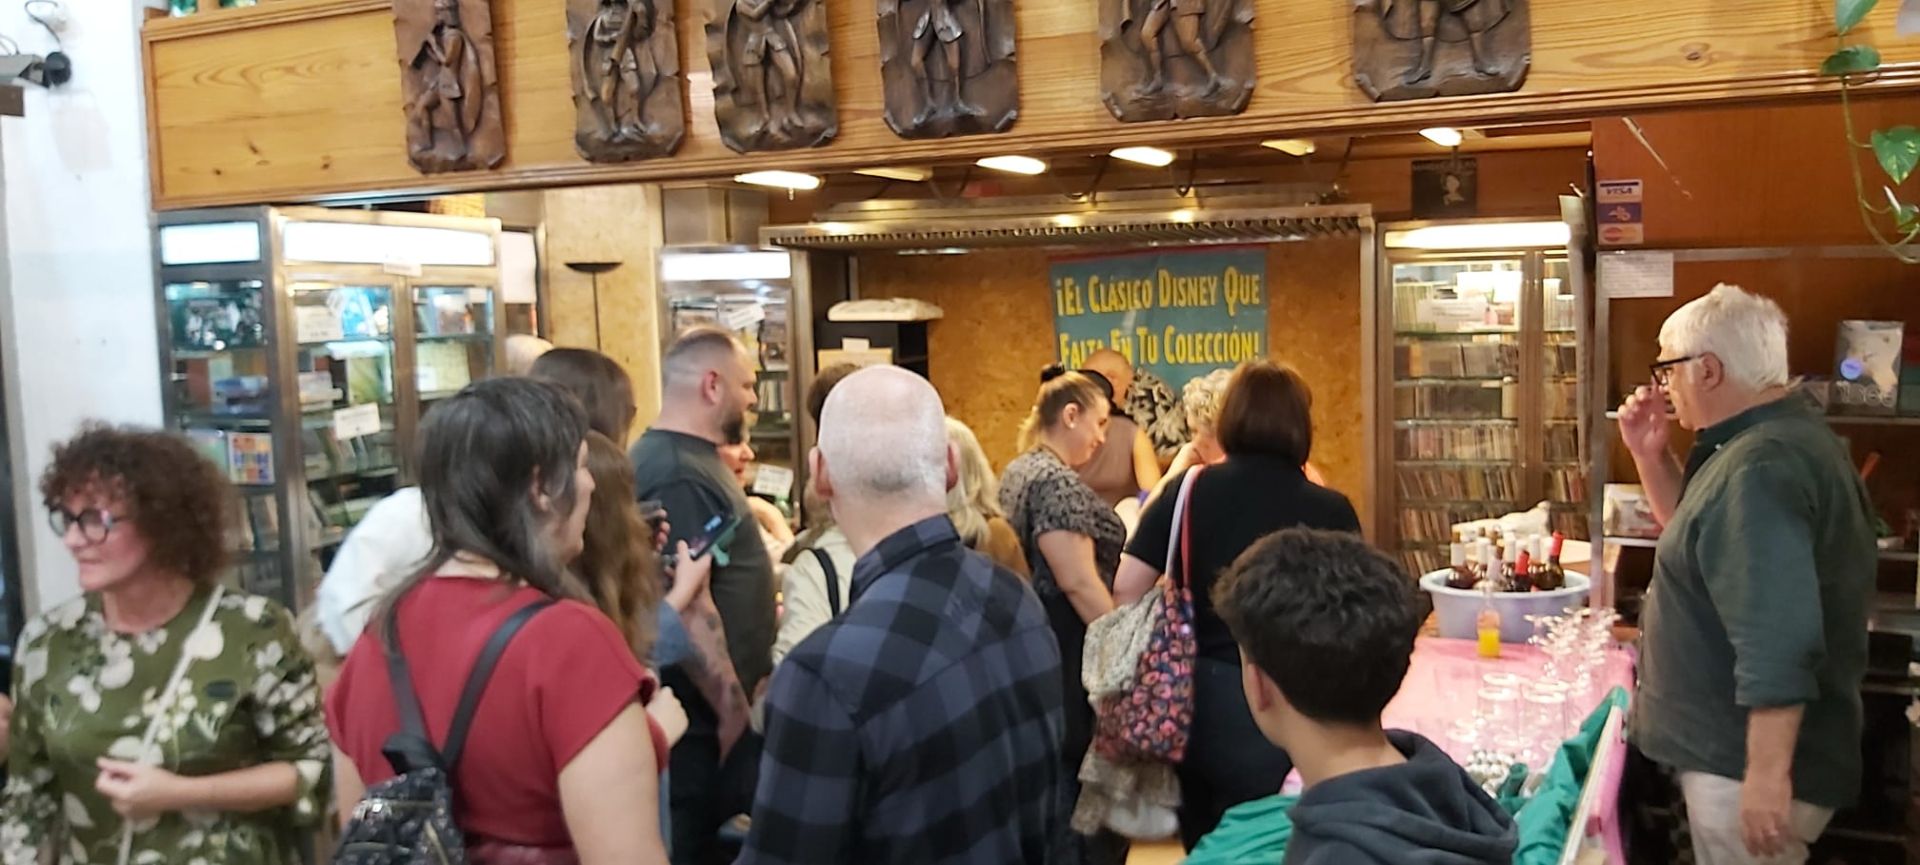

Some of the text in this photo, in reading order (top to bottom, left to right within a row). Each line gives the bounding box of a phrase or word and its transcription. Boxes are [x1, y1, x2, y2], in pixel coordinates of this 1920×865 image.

[1158, 268, 1218, 308] DISNEY
[1223, 266, 1260, 317] QUE
[1060, 333, 1104, 370] FALT
[1136, 326, 1158, 365] TU
